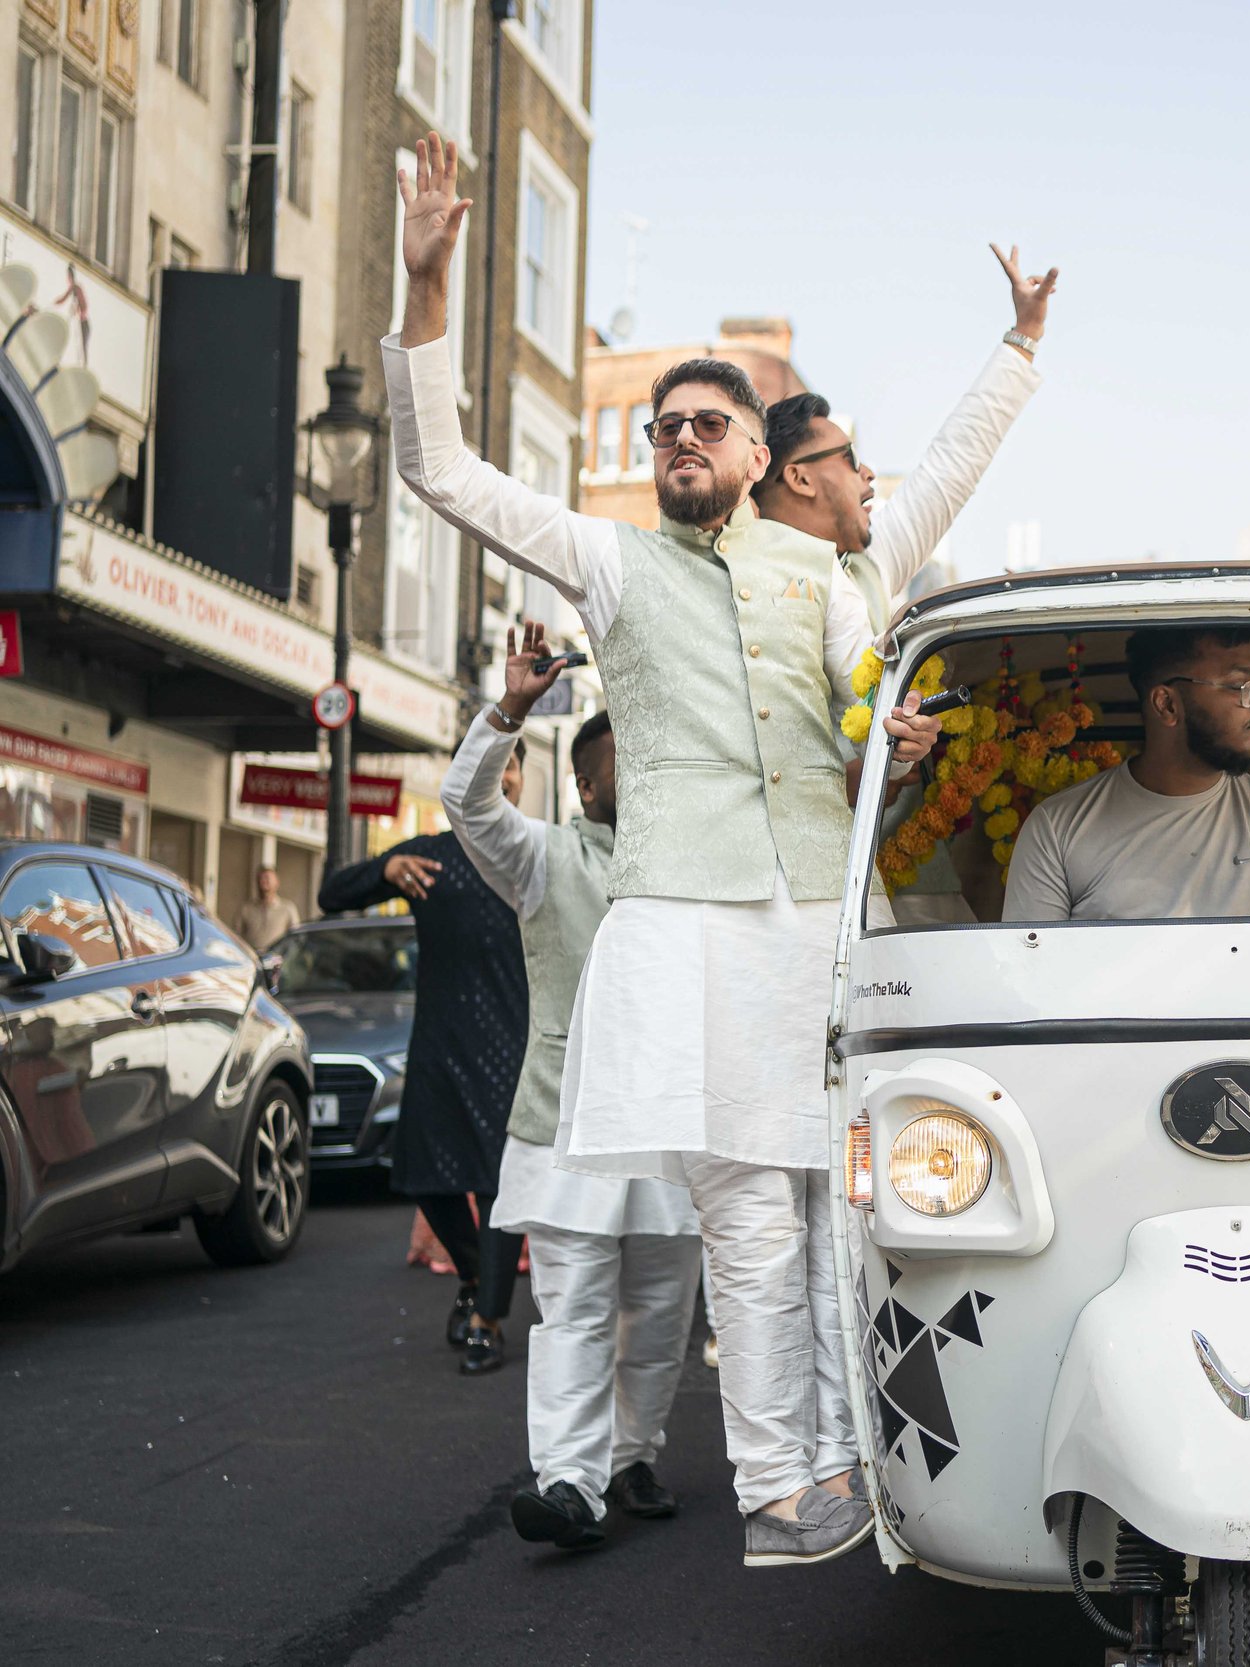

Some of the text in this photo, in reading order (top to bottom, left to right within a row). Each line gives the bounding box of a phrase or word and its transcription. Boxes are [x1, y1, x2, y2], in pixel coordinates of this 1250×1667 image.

[108, 555, 181, 615] OLIVIER,
[186, 588, 229, 632] TONY
[231, 618, 259, 646] AND
[262, 625, 310, 664] OSCAR
[321, 692, 348, 715] 20
[247, 771, 290, 798] VERY
[294, 776, 329, 801] VER
